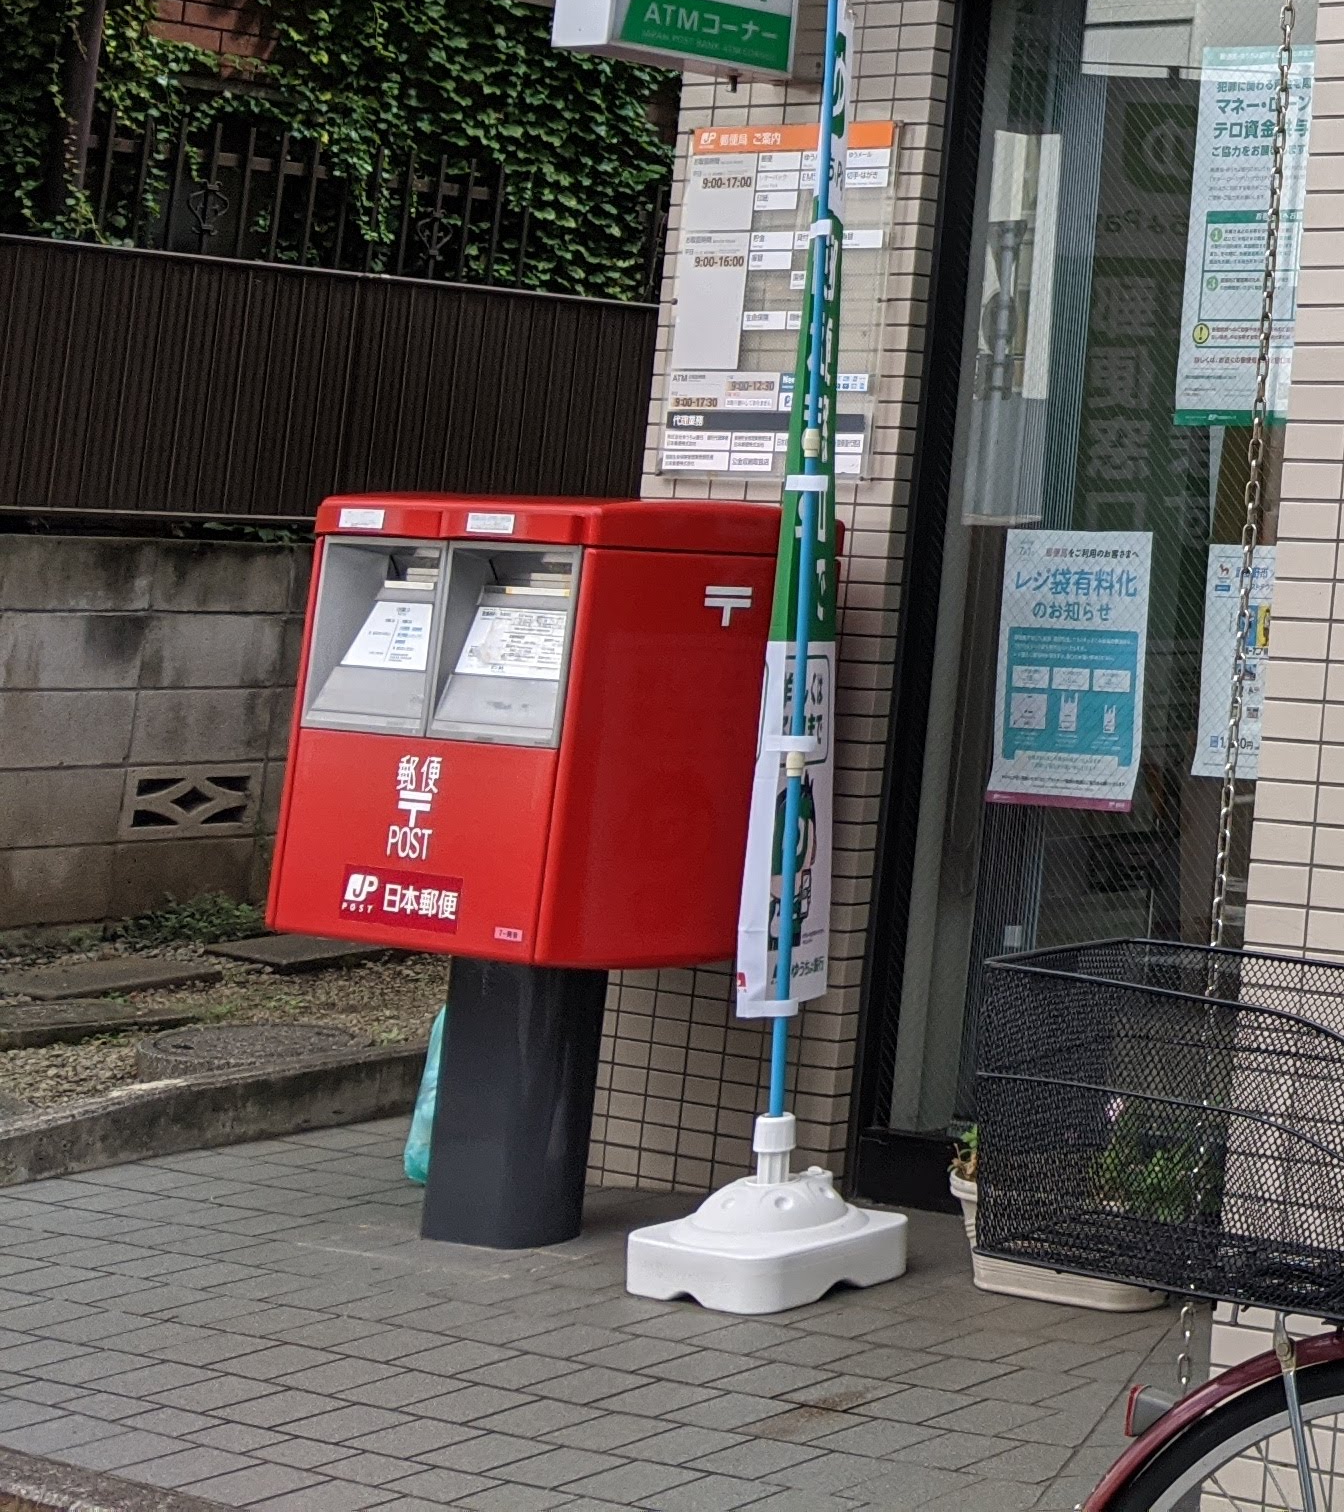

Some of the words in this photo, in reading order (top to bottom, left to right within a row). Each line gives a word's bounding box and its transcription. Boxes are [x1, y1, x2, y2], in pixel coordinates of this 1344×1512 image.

[644, 1, 778, 41] ATMコーナー
[720, 134, 747, 146] 郵便局
[753, 133, 780, 145] ご案内
[702, 176, 751, 189] 9:00-17:00
[694, 255, 745, 267] 9:00-16:00
[672, 374, 688, 382] ATM
[731, 381, 775, 391] 9:00-12:30
[674, 397, 718, 408] 9:00-17:30
[1014, 569, 1138, 597] レジ袋有料化
[1033, 601, 1112, 621] のお知らせ
[396, 755, 442, 793] 郵便
[387, 825, 433, 861] POST
[383, 883, 459, 920] 日本郵便
[341, 903, 373, 914] POST
